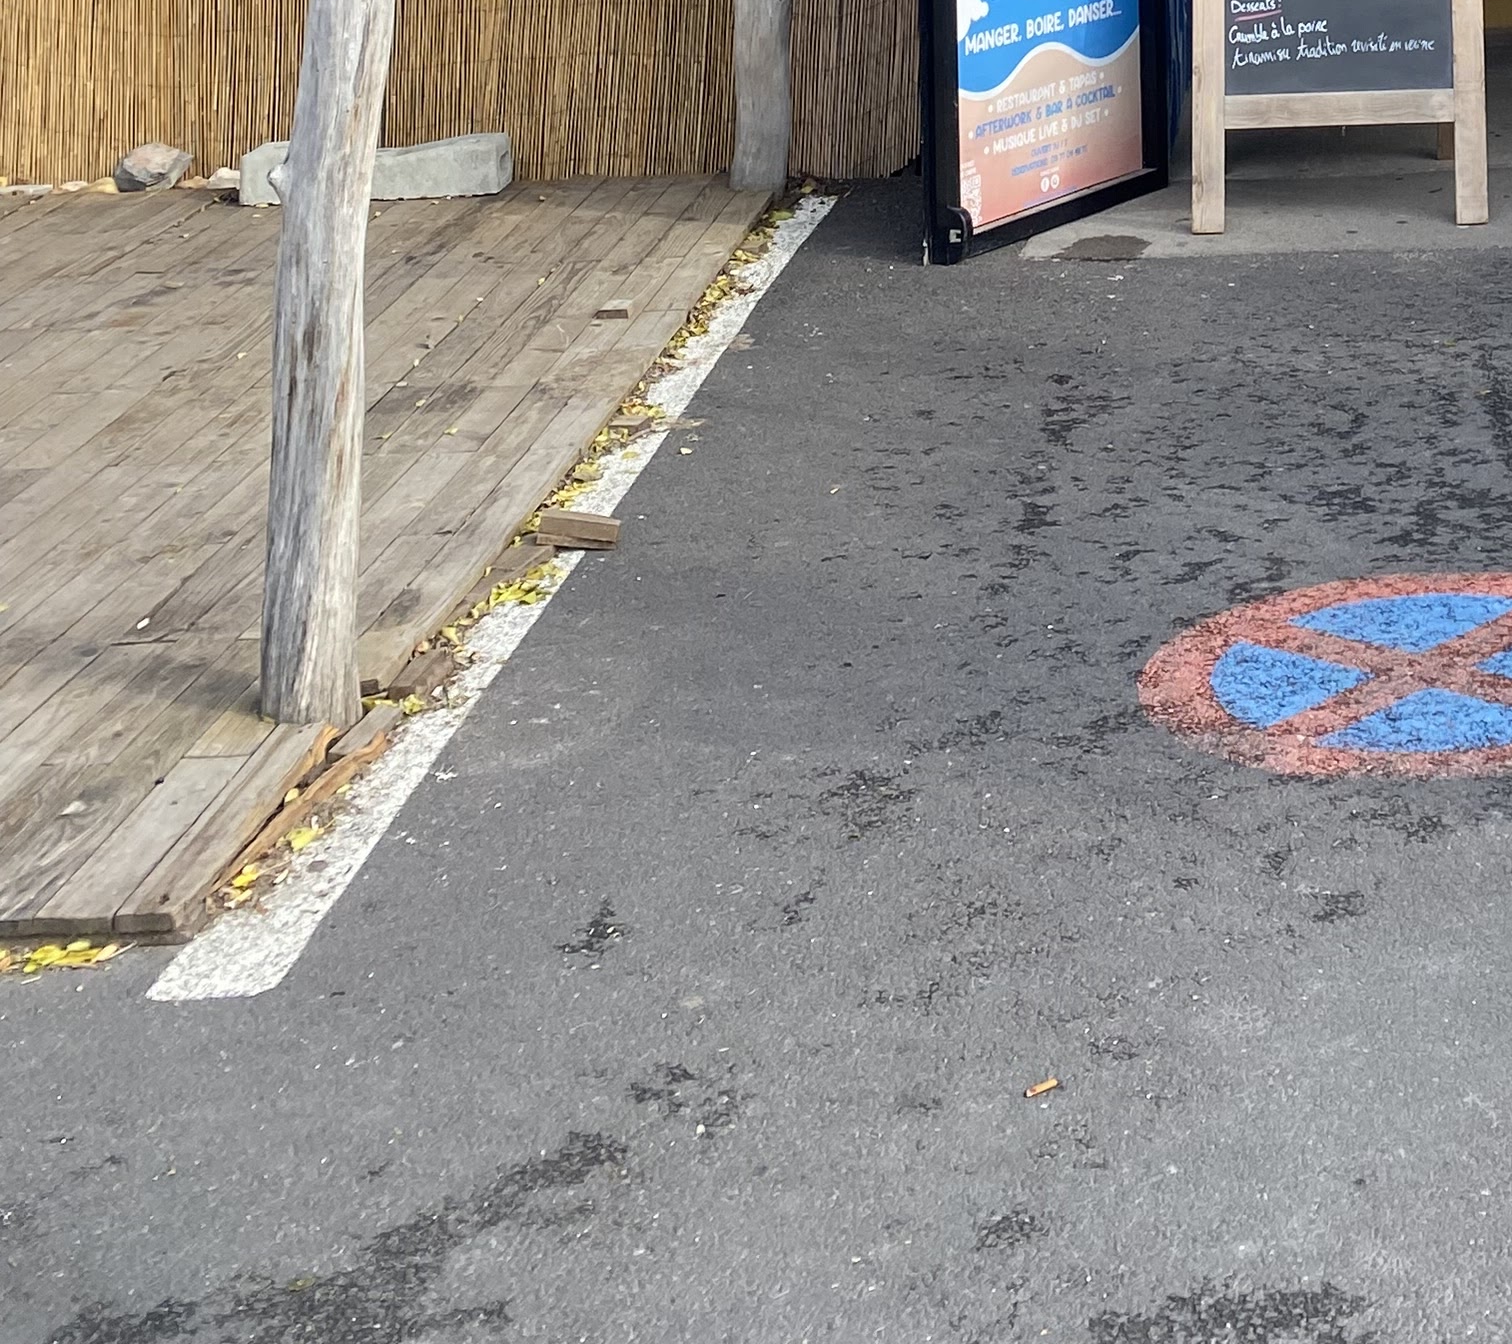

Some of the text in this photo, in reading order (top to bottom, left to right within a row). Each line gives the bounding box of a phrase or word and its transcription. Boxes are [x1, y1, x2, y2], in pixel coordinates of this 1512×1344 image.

[1280, 16, 1297, 36] la
[1297, 19, 1329, 39] poire
[1296, 35, 1348, 61] tradition
[975, 110, 1032, 140] AFTERWORK
[1045, 100, 1063, 118] BAR
[1075, 84, 1116, 107] COCKTAIL
[996, 82, 1057, 113] RESTAURANT
[1069, 70, 1097, 91] TAPAS
[992, 129, 1037, 155] MUSIQUE
[1038, 121, 1059, 141] LIVE
[1085, 107, 1101, 125] SET
